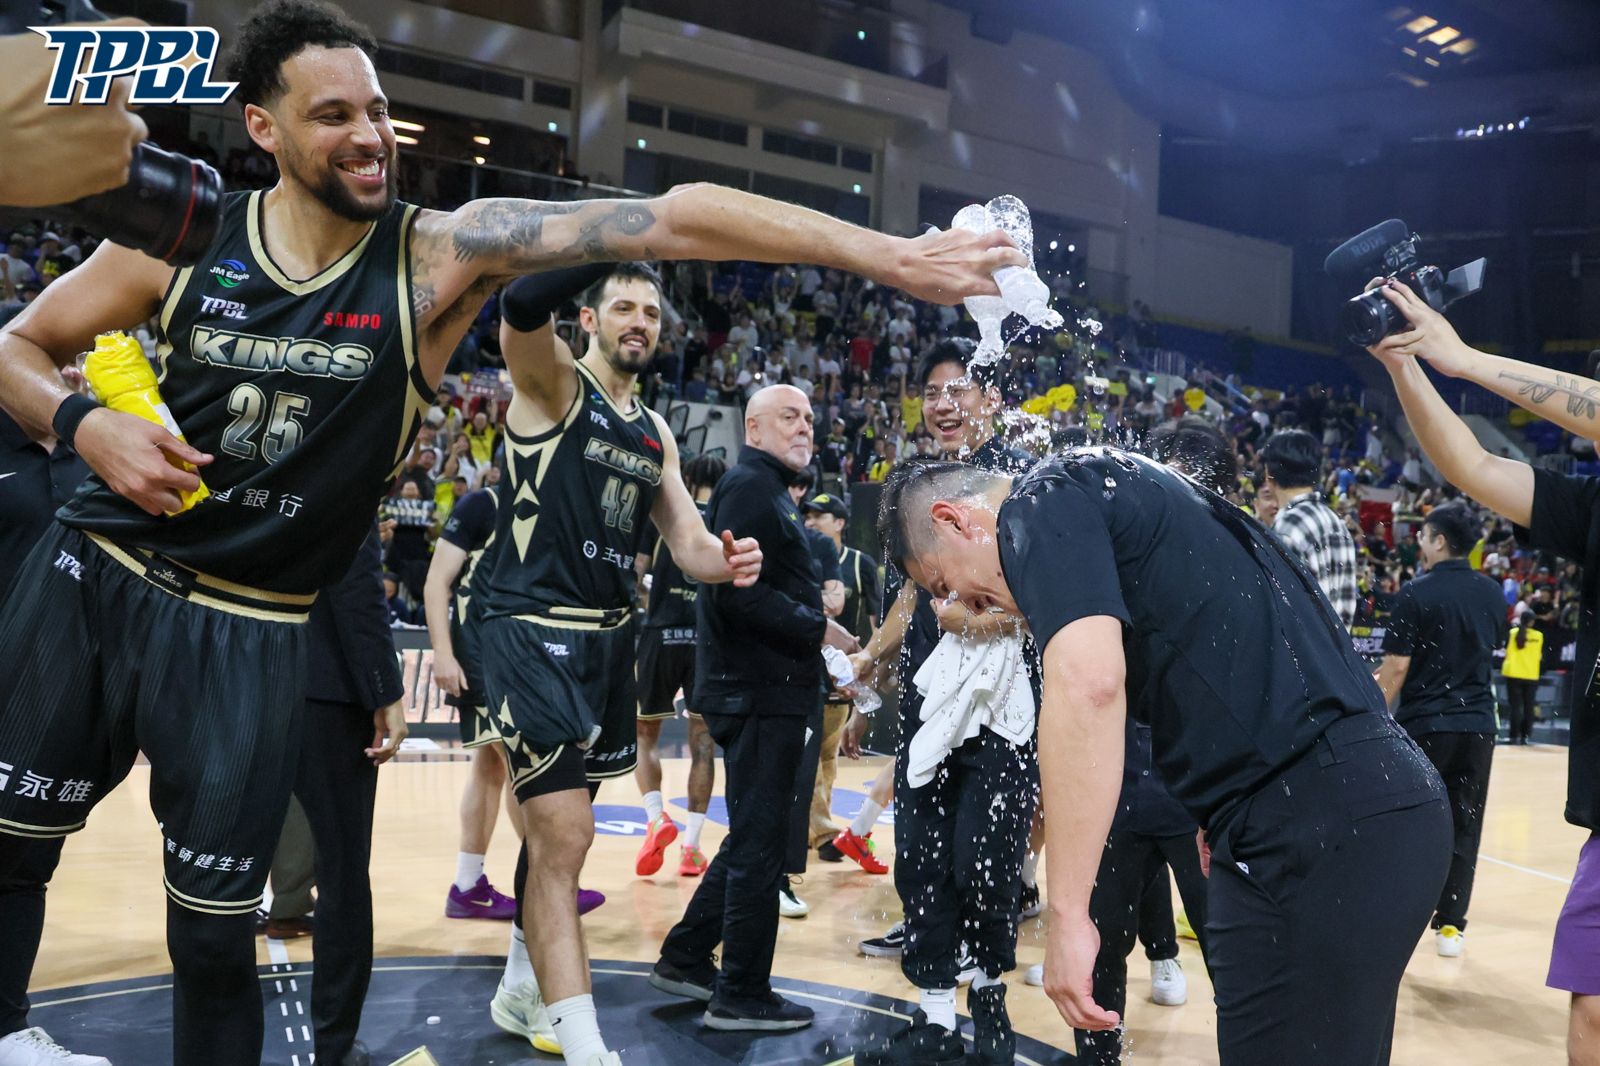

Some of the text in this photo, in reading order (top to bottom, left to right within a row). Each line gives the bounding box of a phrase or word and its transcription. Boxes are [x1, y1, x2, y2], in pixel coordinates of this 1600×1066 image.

[209, 265, 250, 281] JM Eagle
[200, 295, 250, 320] TPBL
[322, 312, 382, 330] SAMPO
[190, 324, 374, 381] KINGS
[220, 382, 312, 466] 25
[584, 436, 664, 487] KINGS
[600, 475, 640, 534] 42
